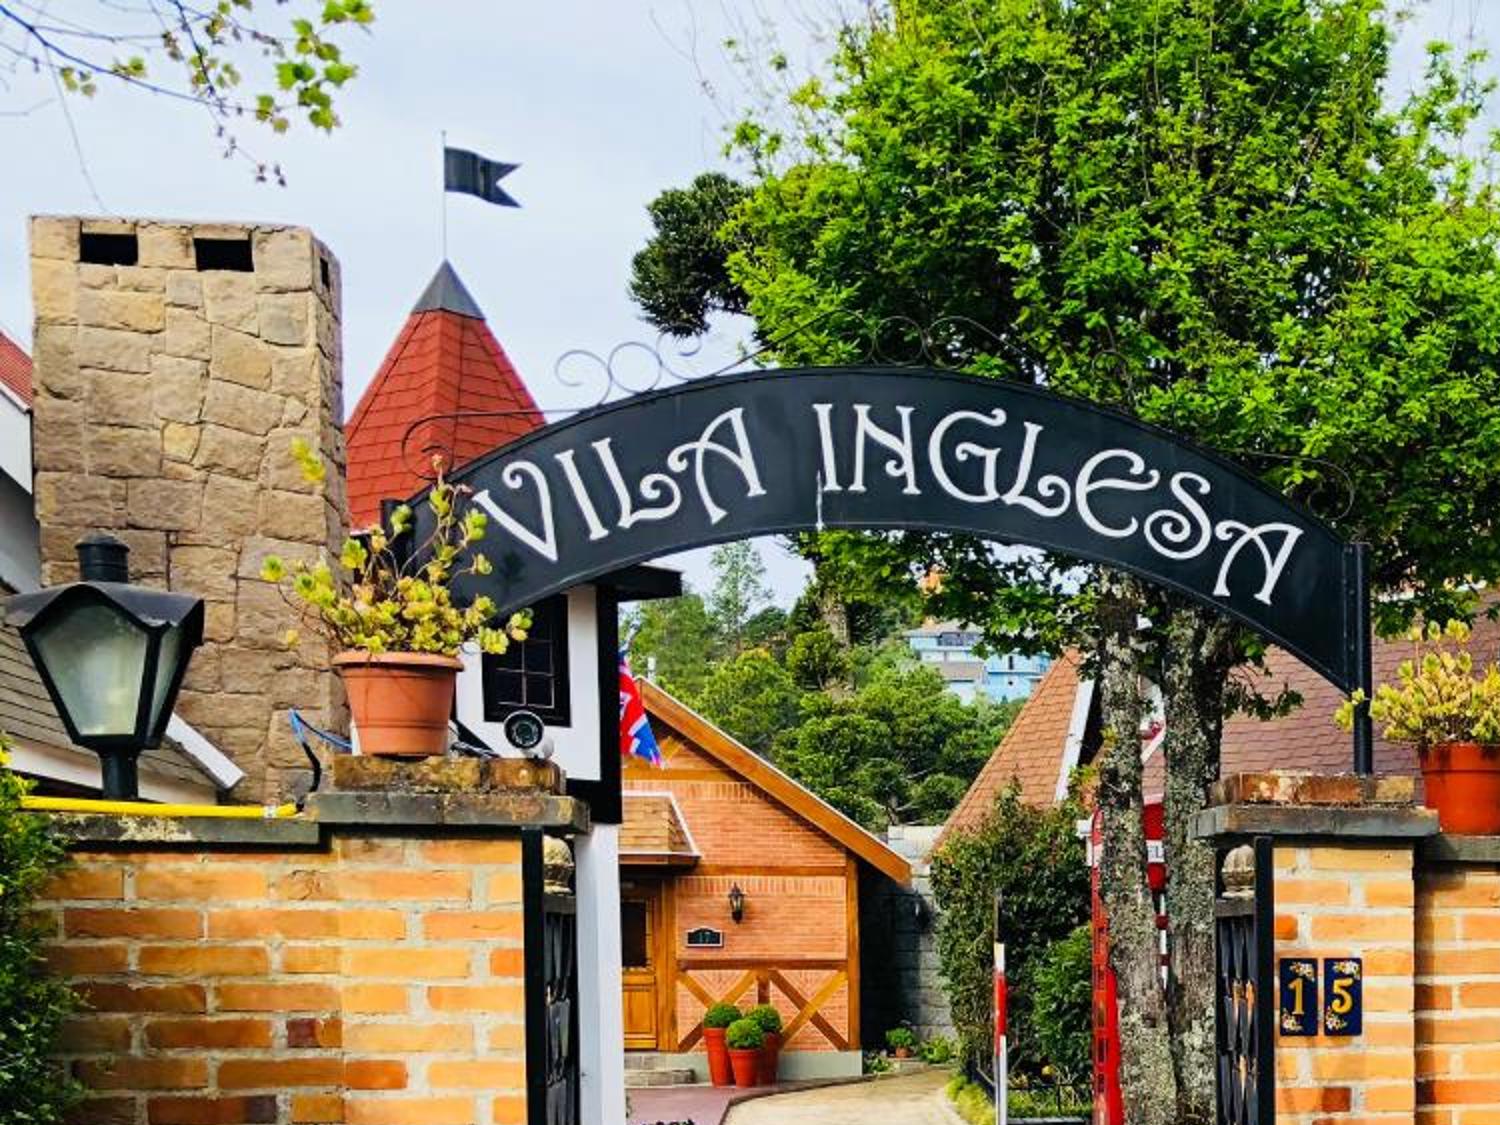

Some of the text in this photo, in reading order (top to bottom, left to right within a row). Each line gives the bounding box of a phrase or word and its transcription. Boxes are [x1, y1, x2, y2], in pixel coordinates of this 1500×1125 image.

[471, 403, 1304, 605] VILA INGLESA
[1288, 978, 1353, 1014] 15
